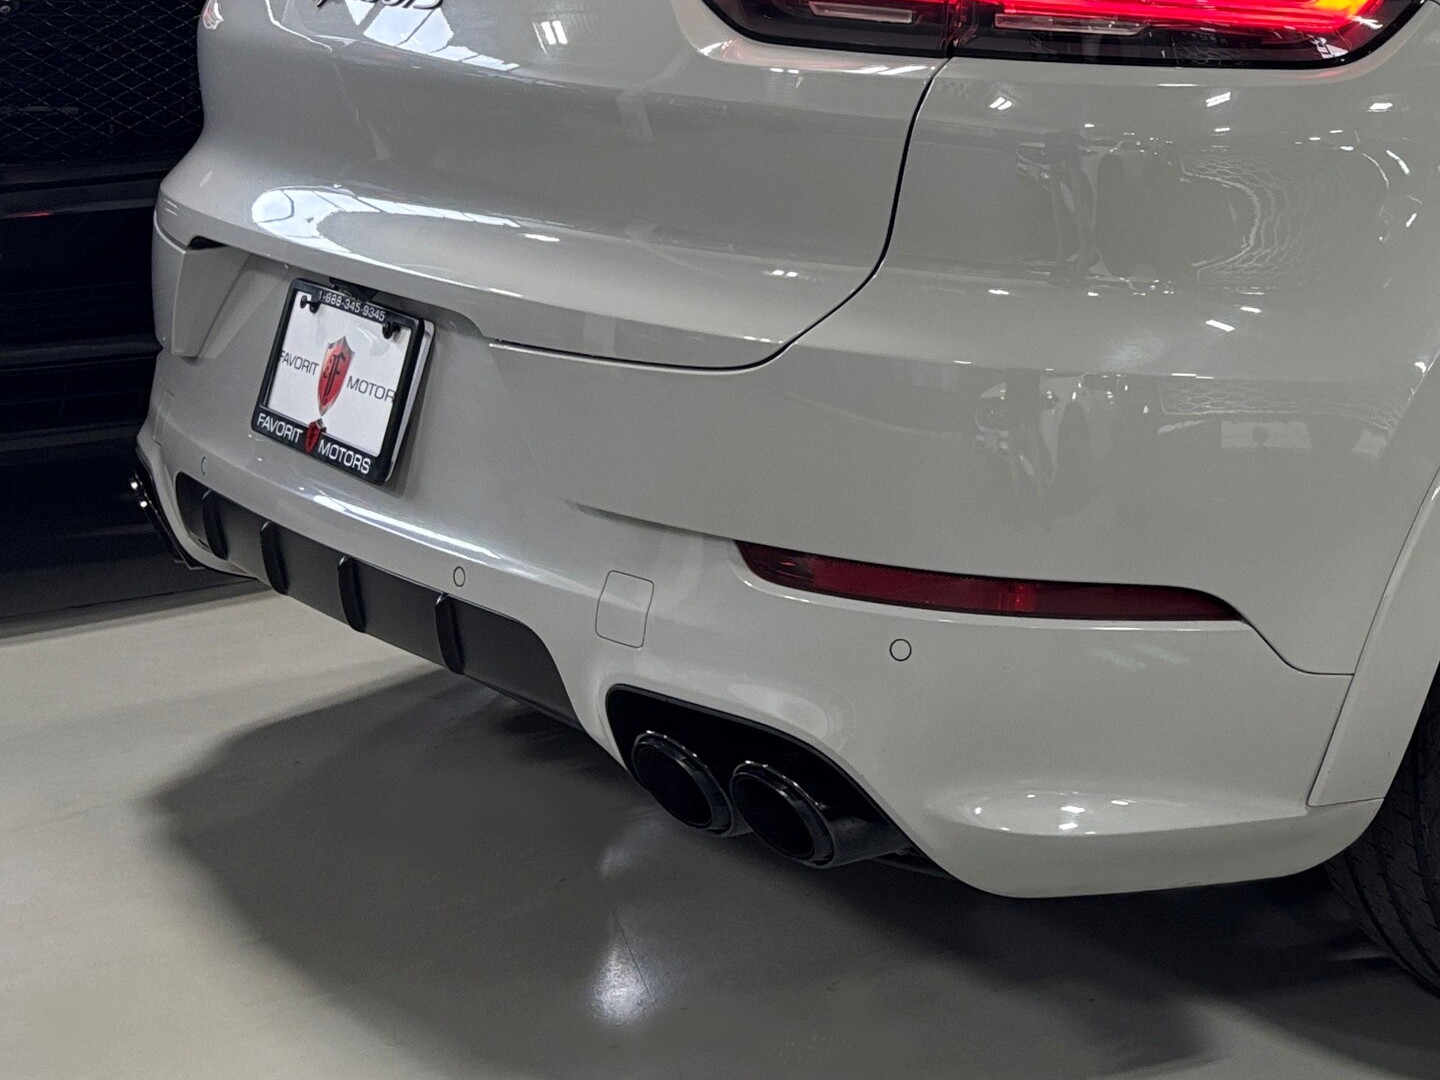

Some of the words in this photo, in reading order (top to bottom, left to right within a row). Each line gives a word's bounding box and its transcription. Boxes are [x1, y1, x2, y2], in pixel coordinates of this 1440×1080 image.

[318, 291, 386, 321] 1-888-345-9345
[257, 413, 303, 444] FAVORIT
[318, 438, 372, 475] MOTORS
